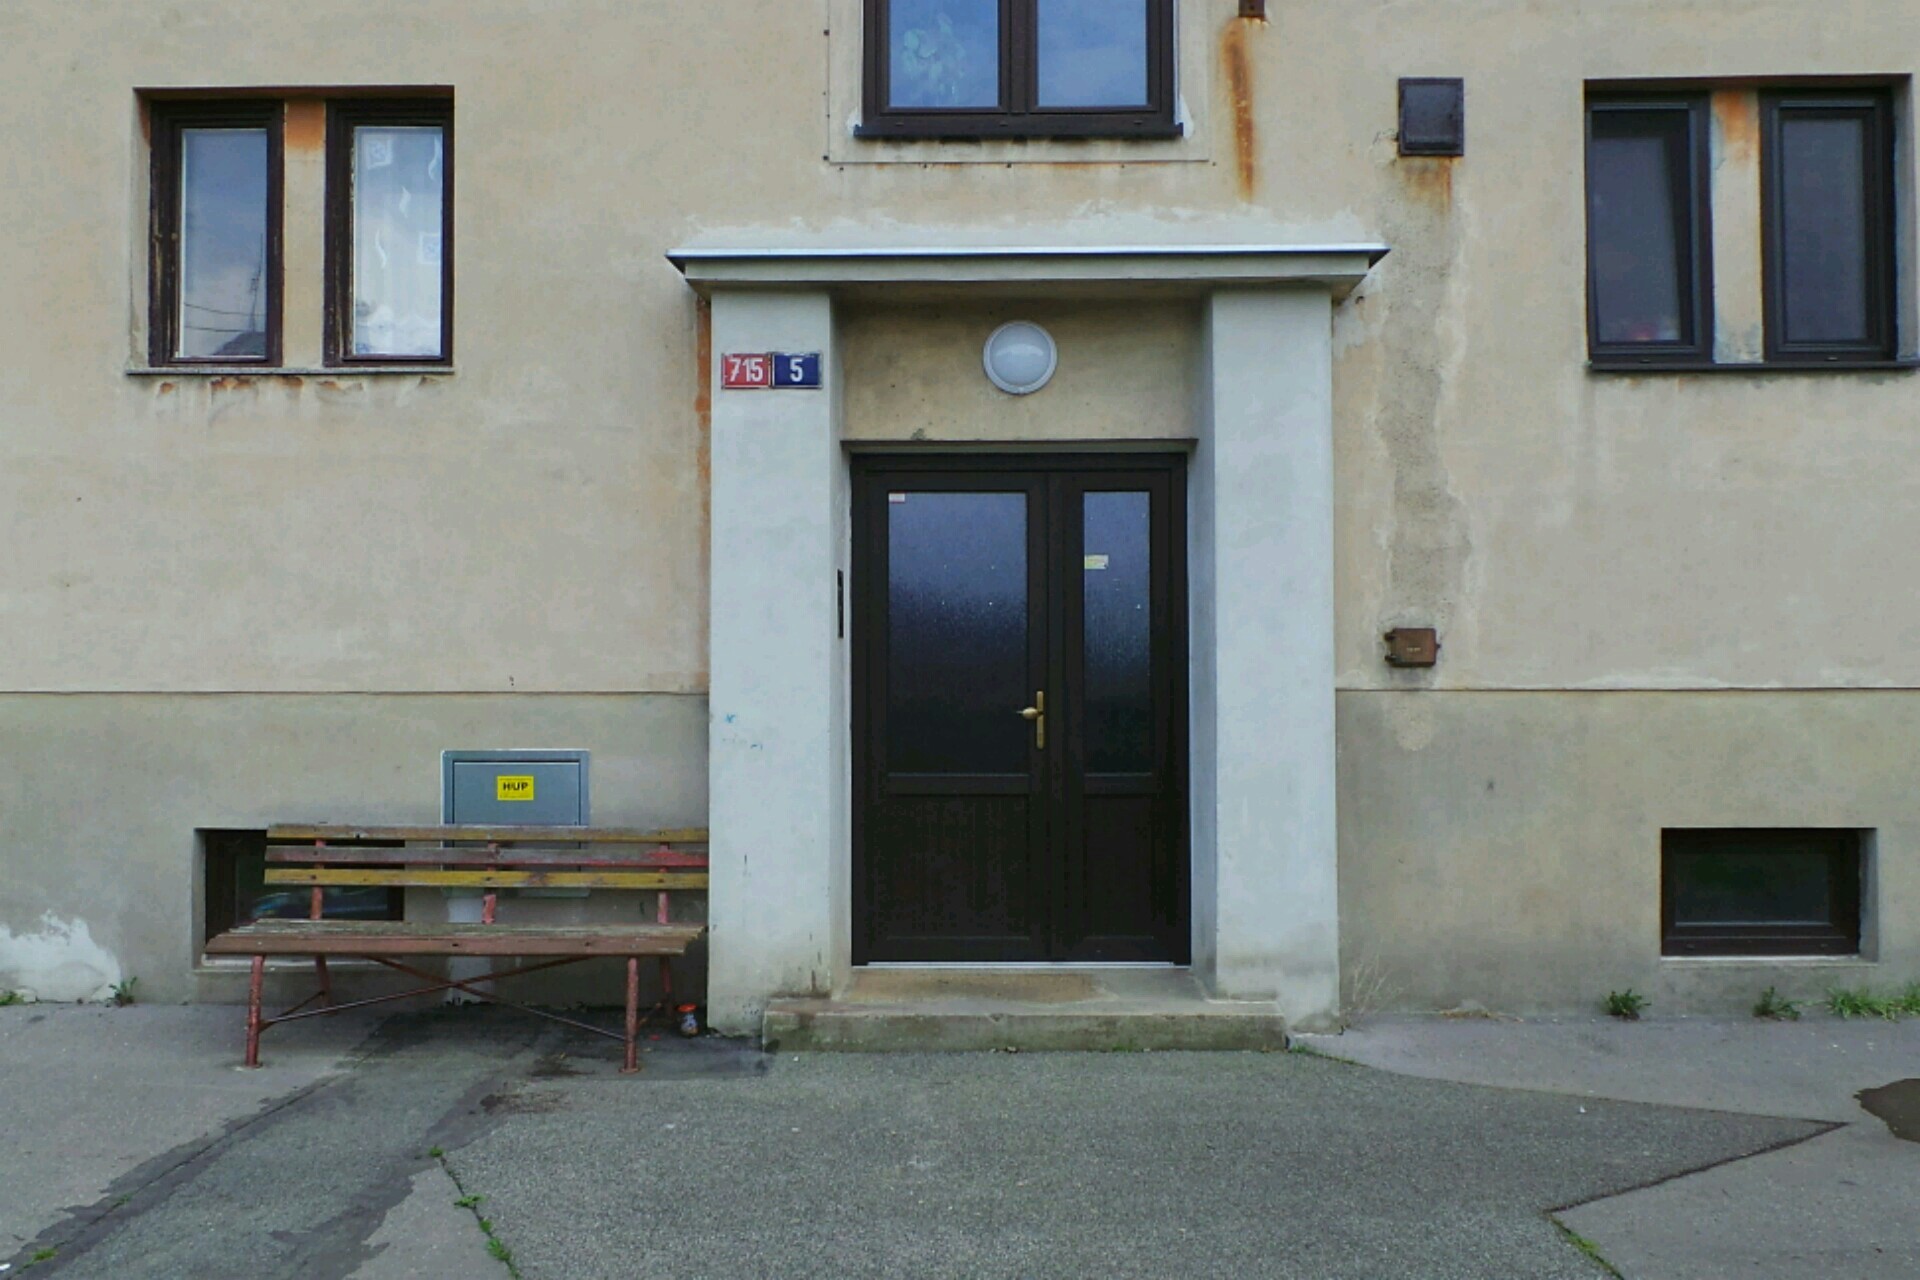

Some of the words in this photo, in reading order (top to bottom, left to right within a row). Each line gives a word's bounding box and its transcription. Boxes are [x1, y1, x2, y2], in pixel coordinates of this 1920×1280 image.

[729, 357, 763, 382] 715
[790, 357, 803, 382] 5
[503, 782, 529, 791] HUP
